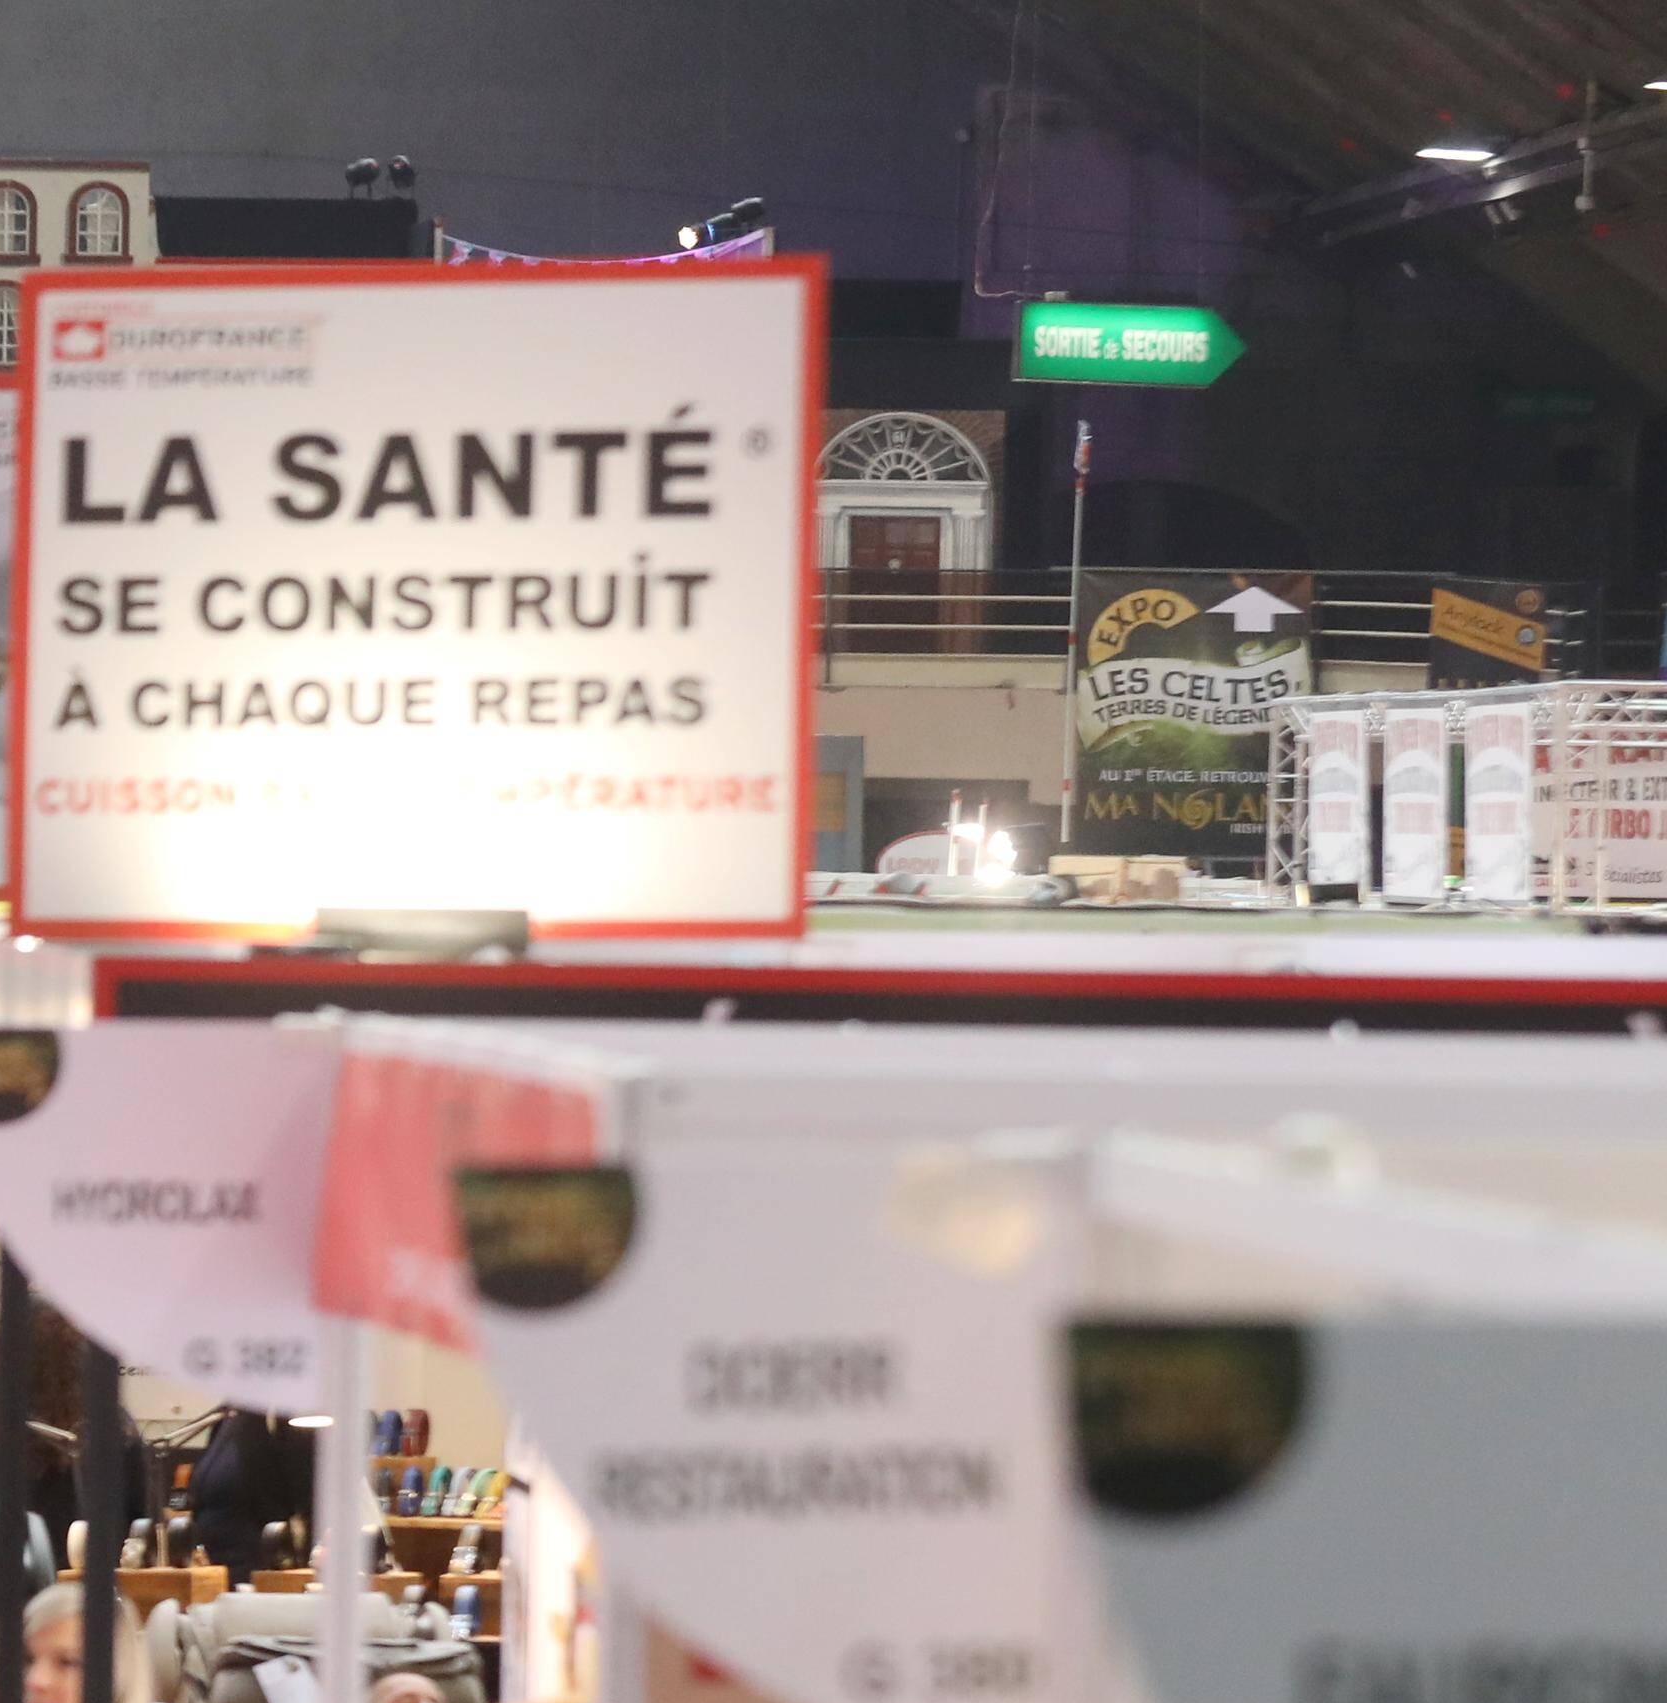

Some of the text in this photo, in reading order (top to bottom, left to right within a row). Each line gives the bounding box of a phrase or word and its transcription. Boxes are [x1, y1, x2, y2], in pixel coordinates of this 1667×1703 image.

[1034, 325, 1103, 358] SORTIE
[1122, 328, 1211, 363] SECOURS
[63, 405, 714, 524] LA SANTÉ
[57, 576, 162, 635] SE
[1098, 596, 1177, 647] EXPO
[55, 672, 707, 731] À CHAQUE REPAS
[1088, 667, 1149, 701] LES
[1093, 699, 1271, 725] TERRES DE LÉGEN
[1098, 769, 1118, 783] AU
